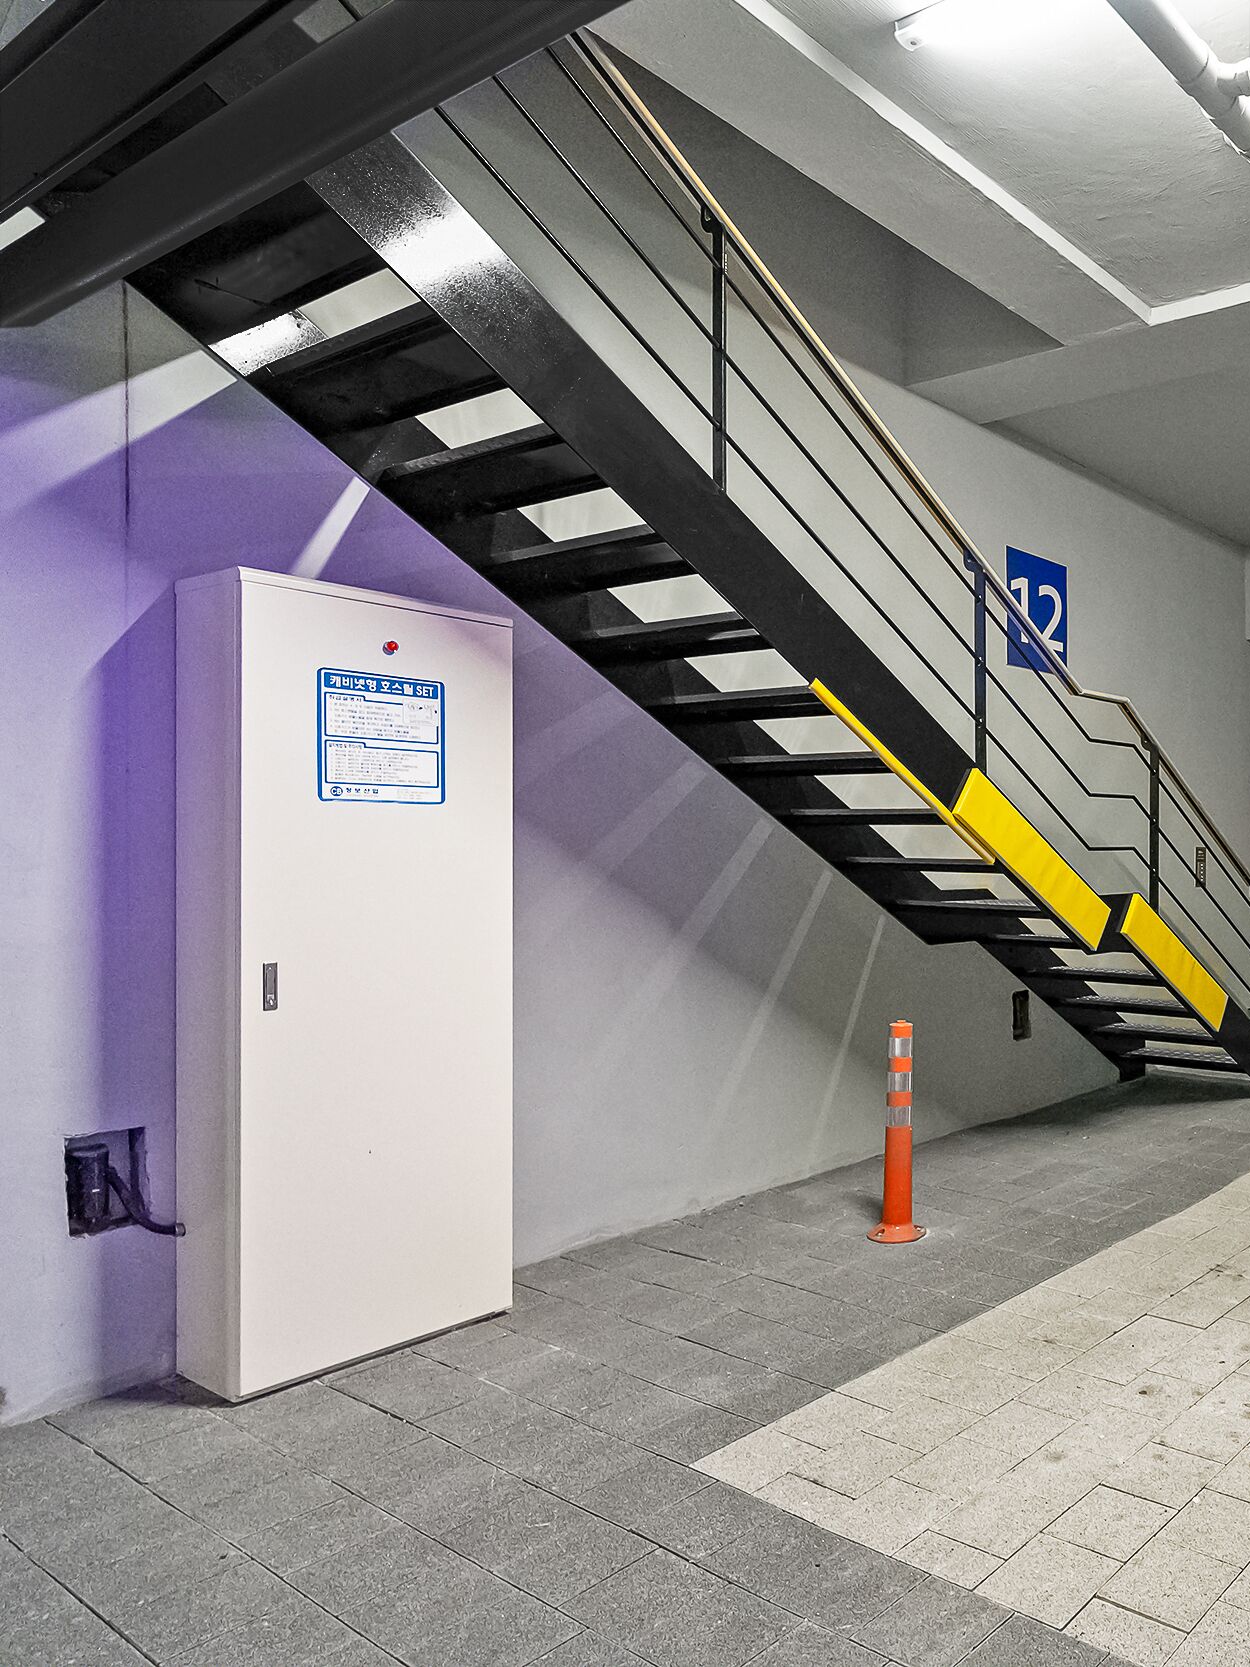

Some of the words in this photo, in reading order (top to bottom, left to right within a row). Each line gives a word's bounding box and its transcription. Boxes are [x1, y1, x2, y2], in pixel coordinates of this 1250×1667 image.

[1010, 577, 1064, 653] 12
[329, 675, 377, 692] 캐비넷형
[416, 686, 434, 697] SET
